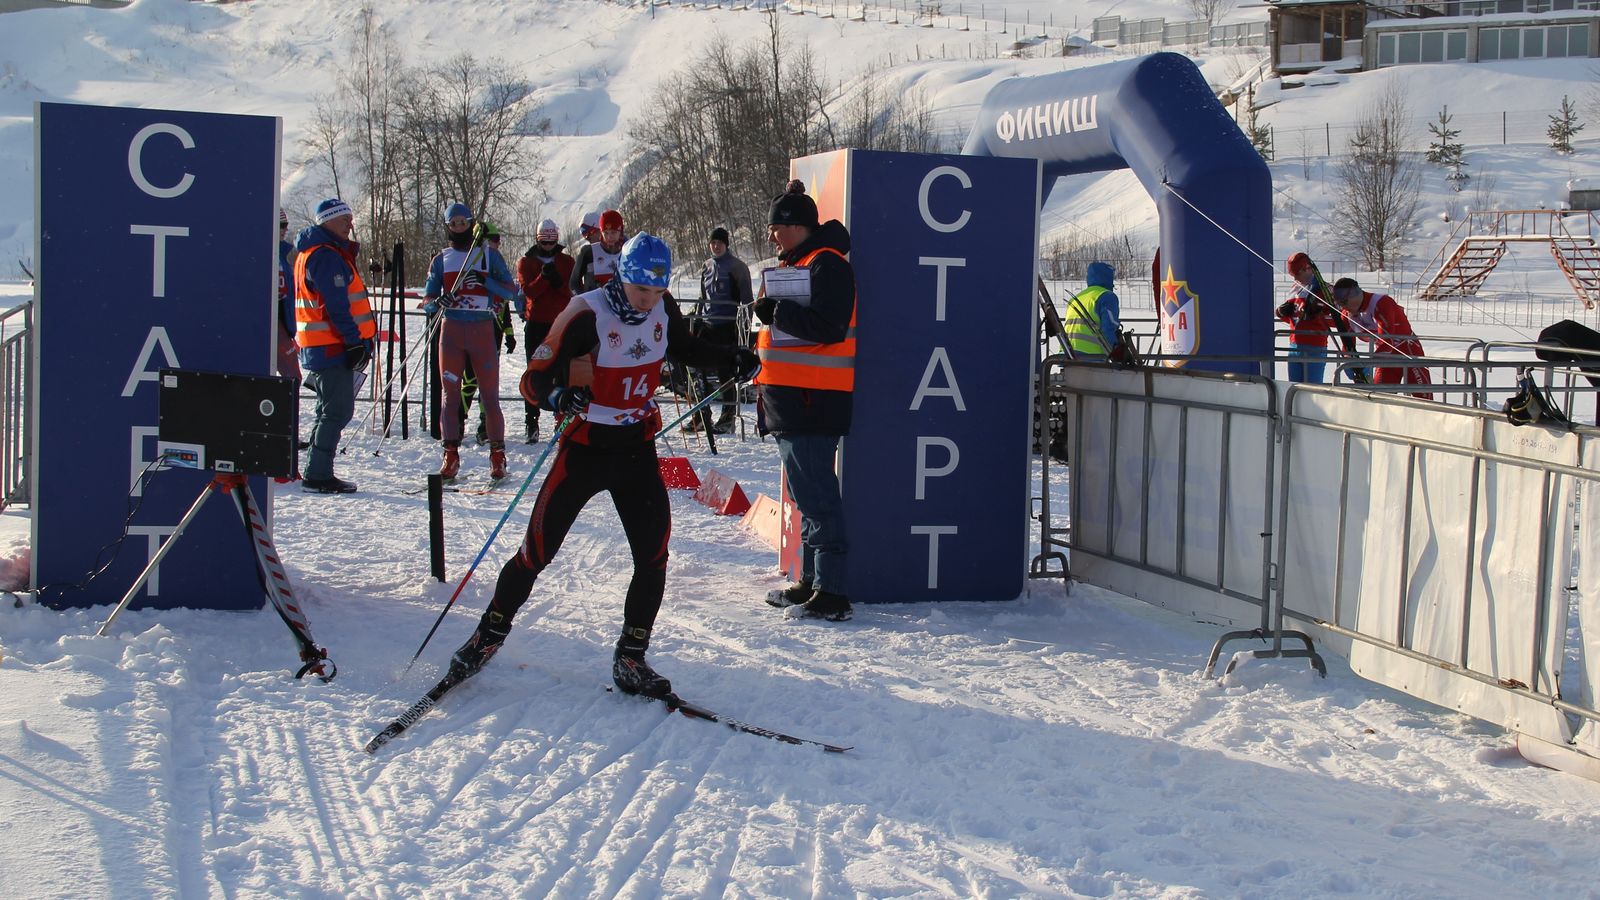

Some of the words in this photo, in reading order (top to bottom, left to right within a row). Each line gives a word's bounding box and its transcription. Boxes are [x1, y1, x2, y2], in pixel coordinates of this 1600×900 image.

[996, 94, 1098, 144] ФИНИШ
[622, 374, 648, 400] 14
[909, 166, 973, 589] СТАРТ
[397, 695, 434, 729] ROSSIGNOL
